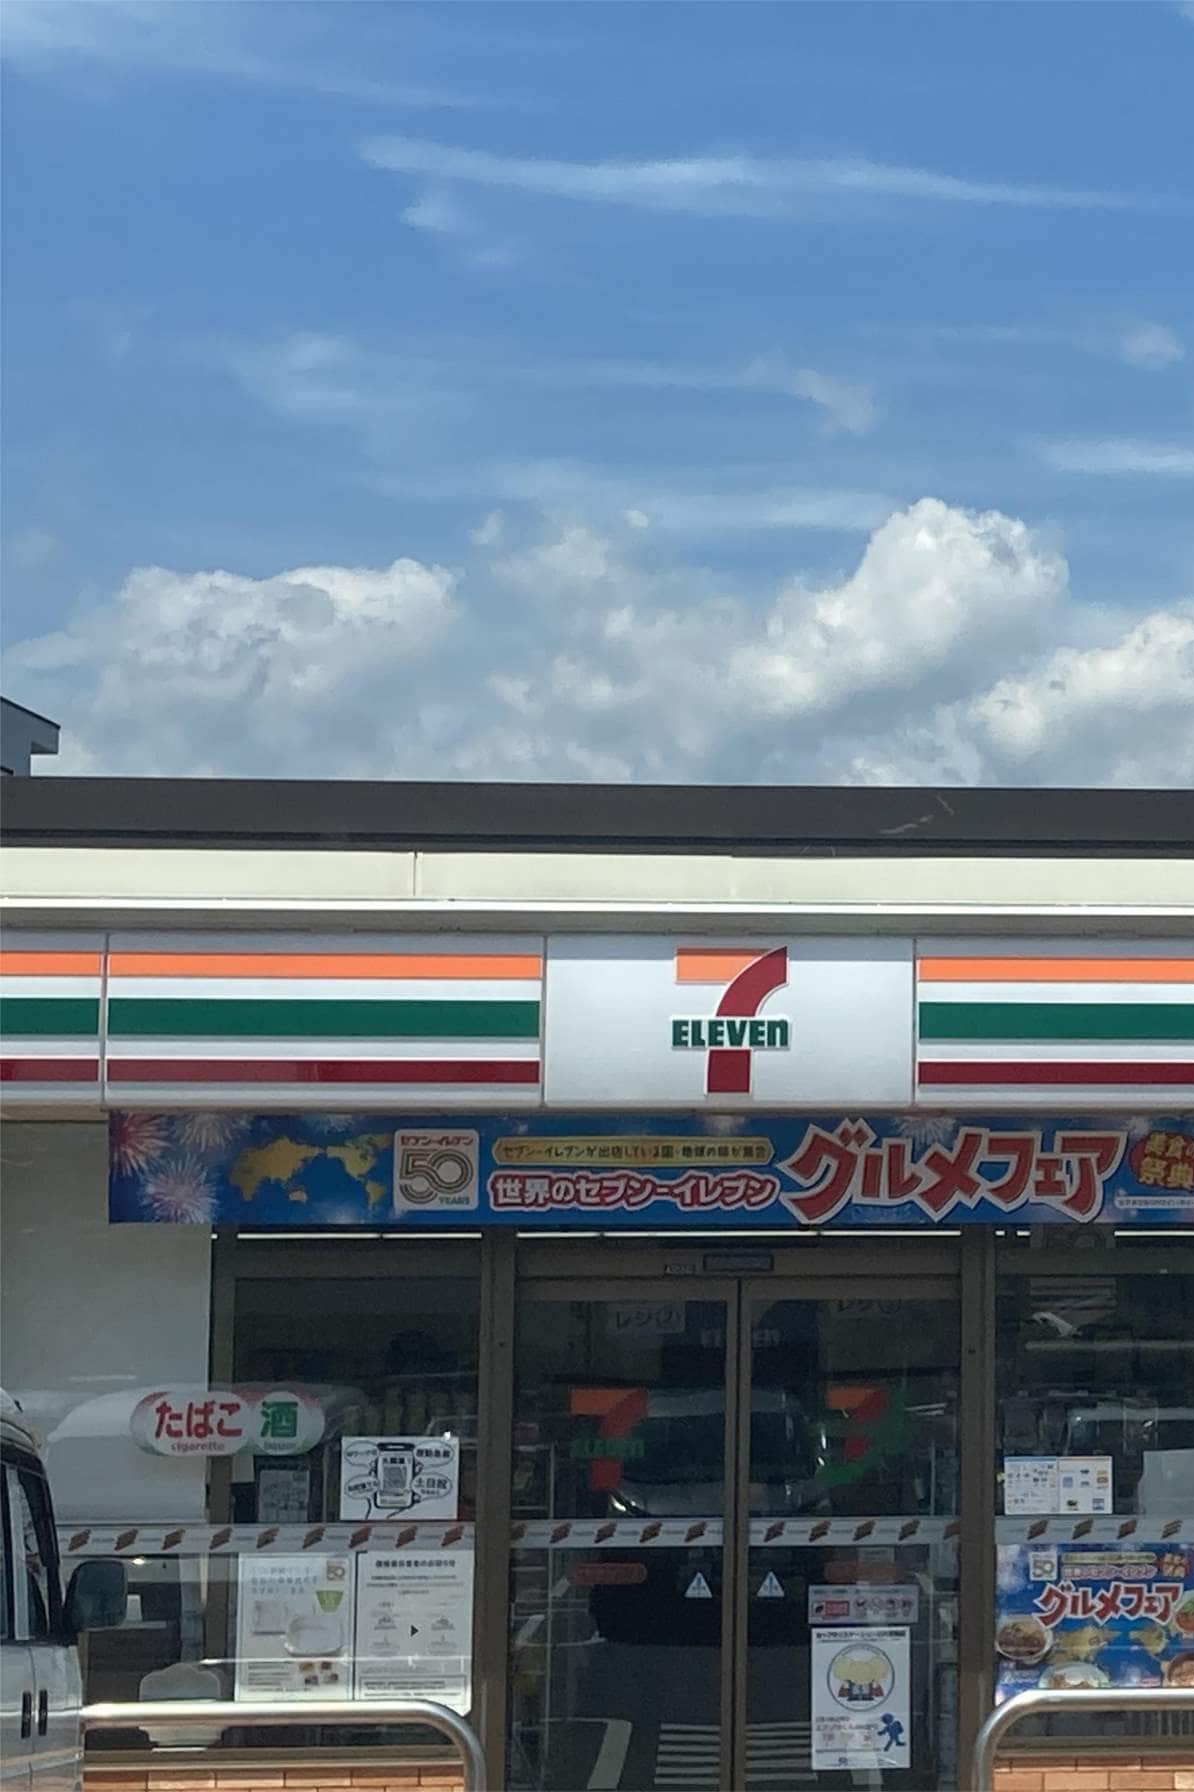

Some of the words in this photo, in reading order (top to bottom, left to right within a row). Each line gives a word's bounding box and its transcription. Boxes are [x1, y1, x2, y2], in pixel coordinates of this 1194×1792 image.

[399, 1148, 474, 1204] 50
[784, 1122, 1124, 1222] グルメフェア
[154, 1400, 243, 1438] たばこ
[260, 1400, 300, 1438] 酒
[1036, 1581, 1184, 1628] グルメフェア
